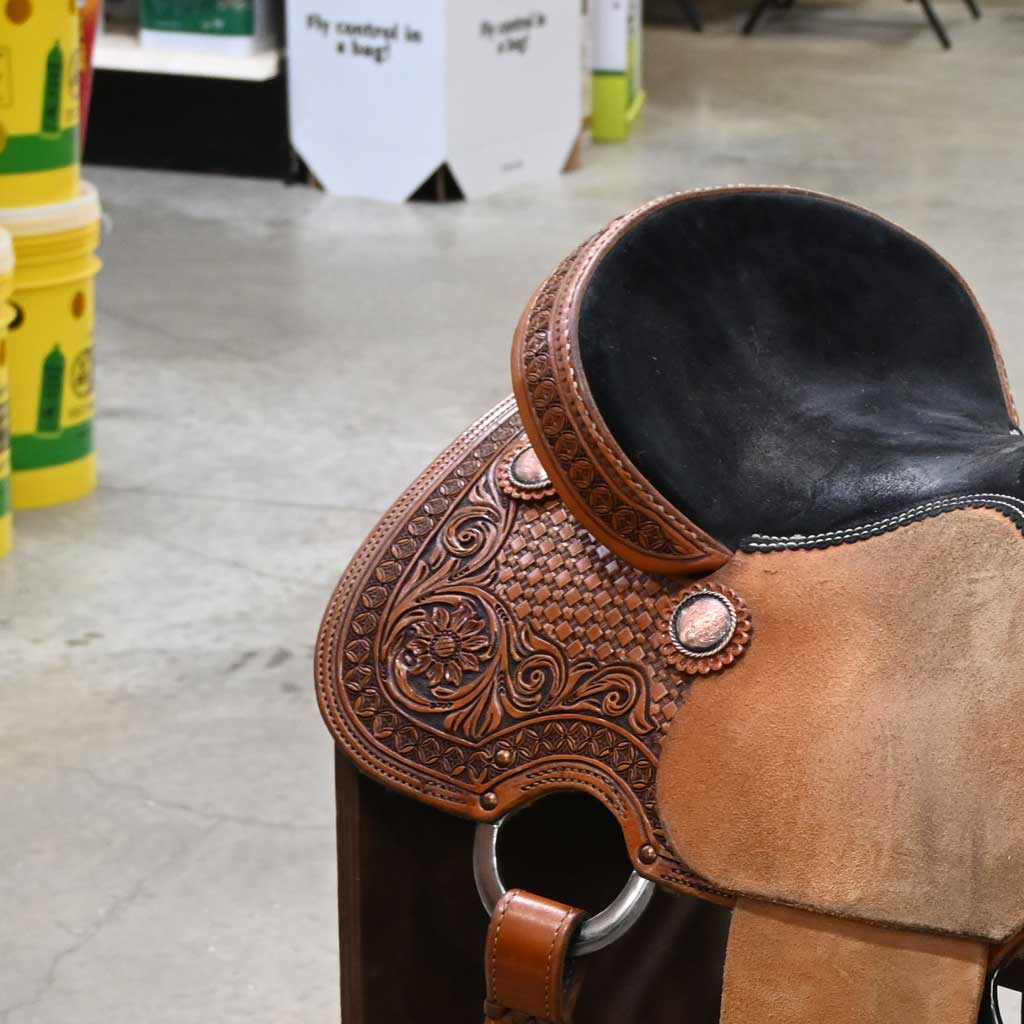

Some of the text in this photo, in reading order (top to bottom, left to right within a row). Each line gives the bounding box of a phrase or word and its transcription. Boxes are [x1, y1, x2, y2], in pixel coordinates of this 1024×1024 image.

[305, 13, 423, 43] Fly control in
